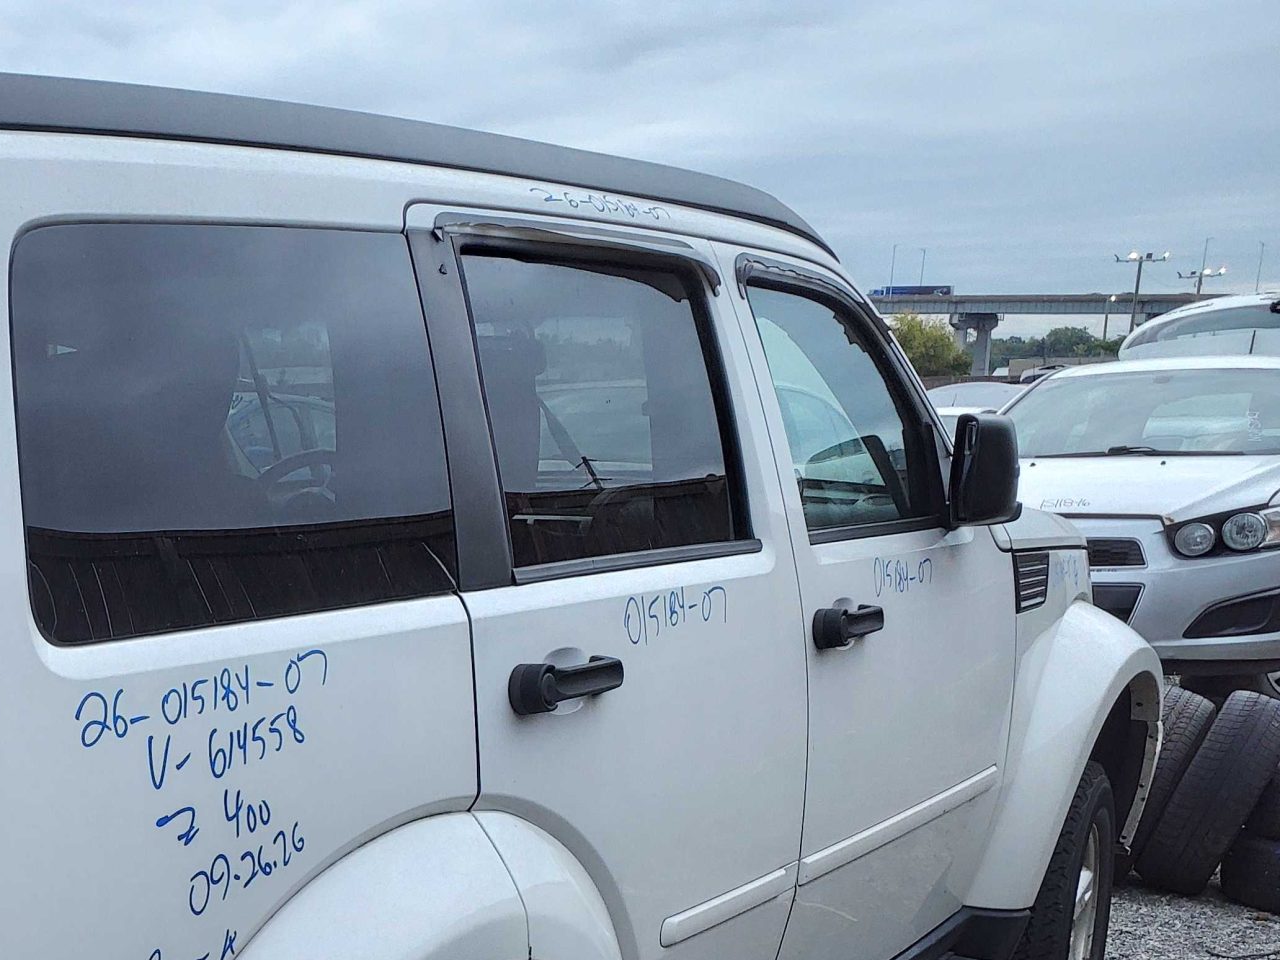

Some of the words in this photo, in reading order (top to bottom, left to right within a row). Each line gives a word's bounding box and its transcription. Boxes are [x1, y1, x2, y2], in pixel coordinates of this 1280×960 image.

[623, 586, 727, 646] 015184-07
[75, 649, 328, 748] 26-015184-07
[223, 788, 272, 838] 400
